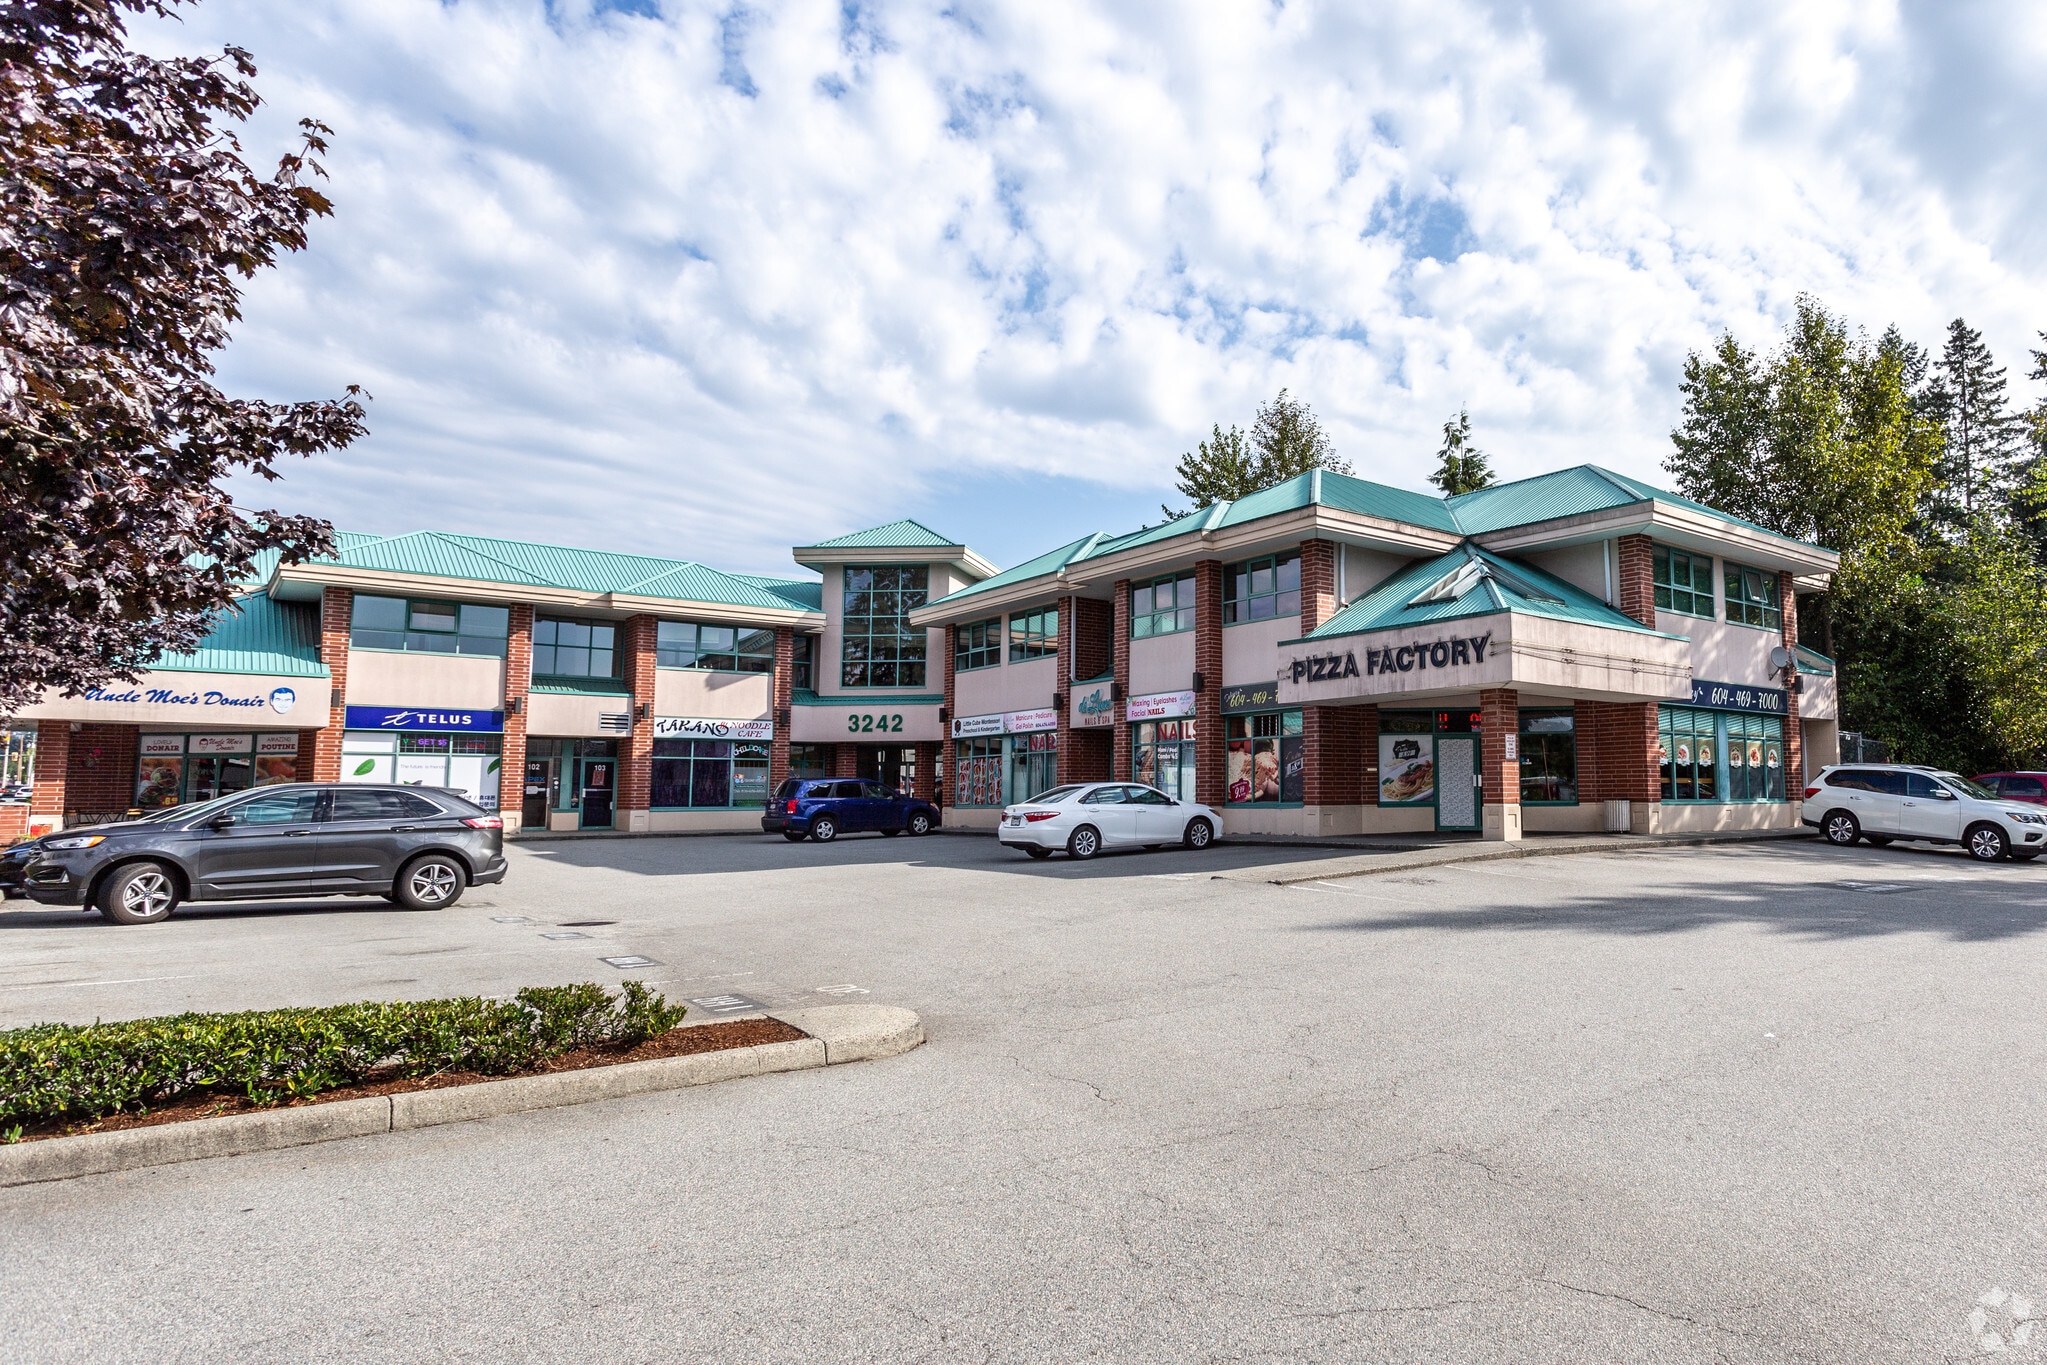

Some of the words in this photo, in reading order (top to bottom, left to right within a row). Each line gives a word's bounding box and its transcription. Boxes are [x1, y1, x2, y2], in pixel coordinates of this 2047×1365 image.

[1292, 653, 1360, 684] PIZZA
[1367, 636, 1490, 676] FACTORY
[85, 687, 141, 702] Uncle
[145, 689, 199, 705] Moe's
[203, 691, 264, 707] Donair
[417, 713, 472, 725] TELUS
[1131, 709, 1146, 717] Facial
[1147, 707, 1165, 716] NAILS
[656, 719, 729, 737] TAKANO
[729, 721, 771, 730] NOODLE
[848, 714, 903, 732] 3242
[1084, 718, 1096, 726] NAILS
[1102, 716, 1111, 724] SPA
[737, 730, 763, 738] CAFE
